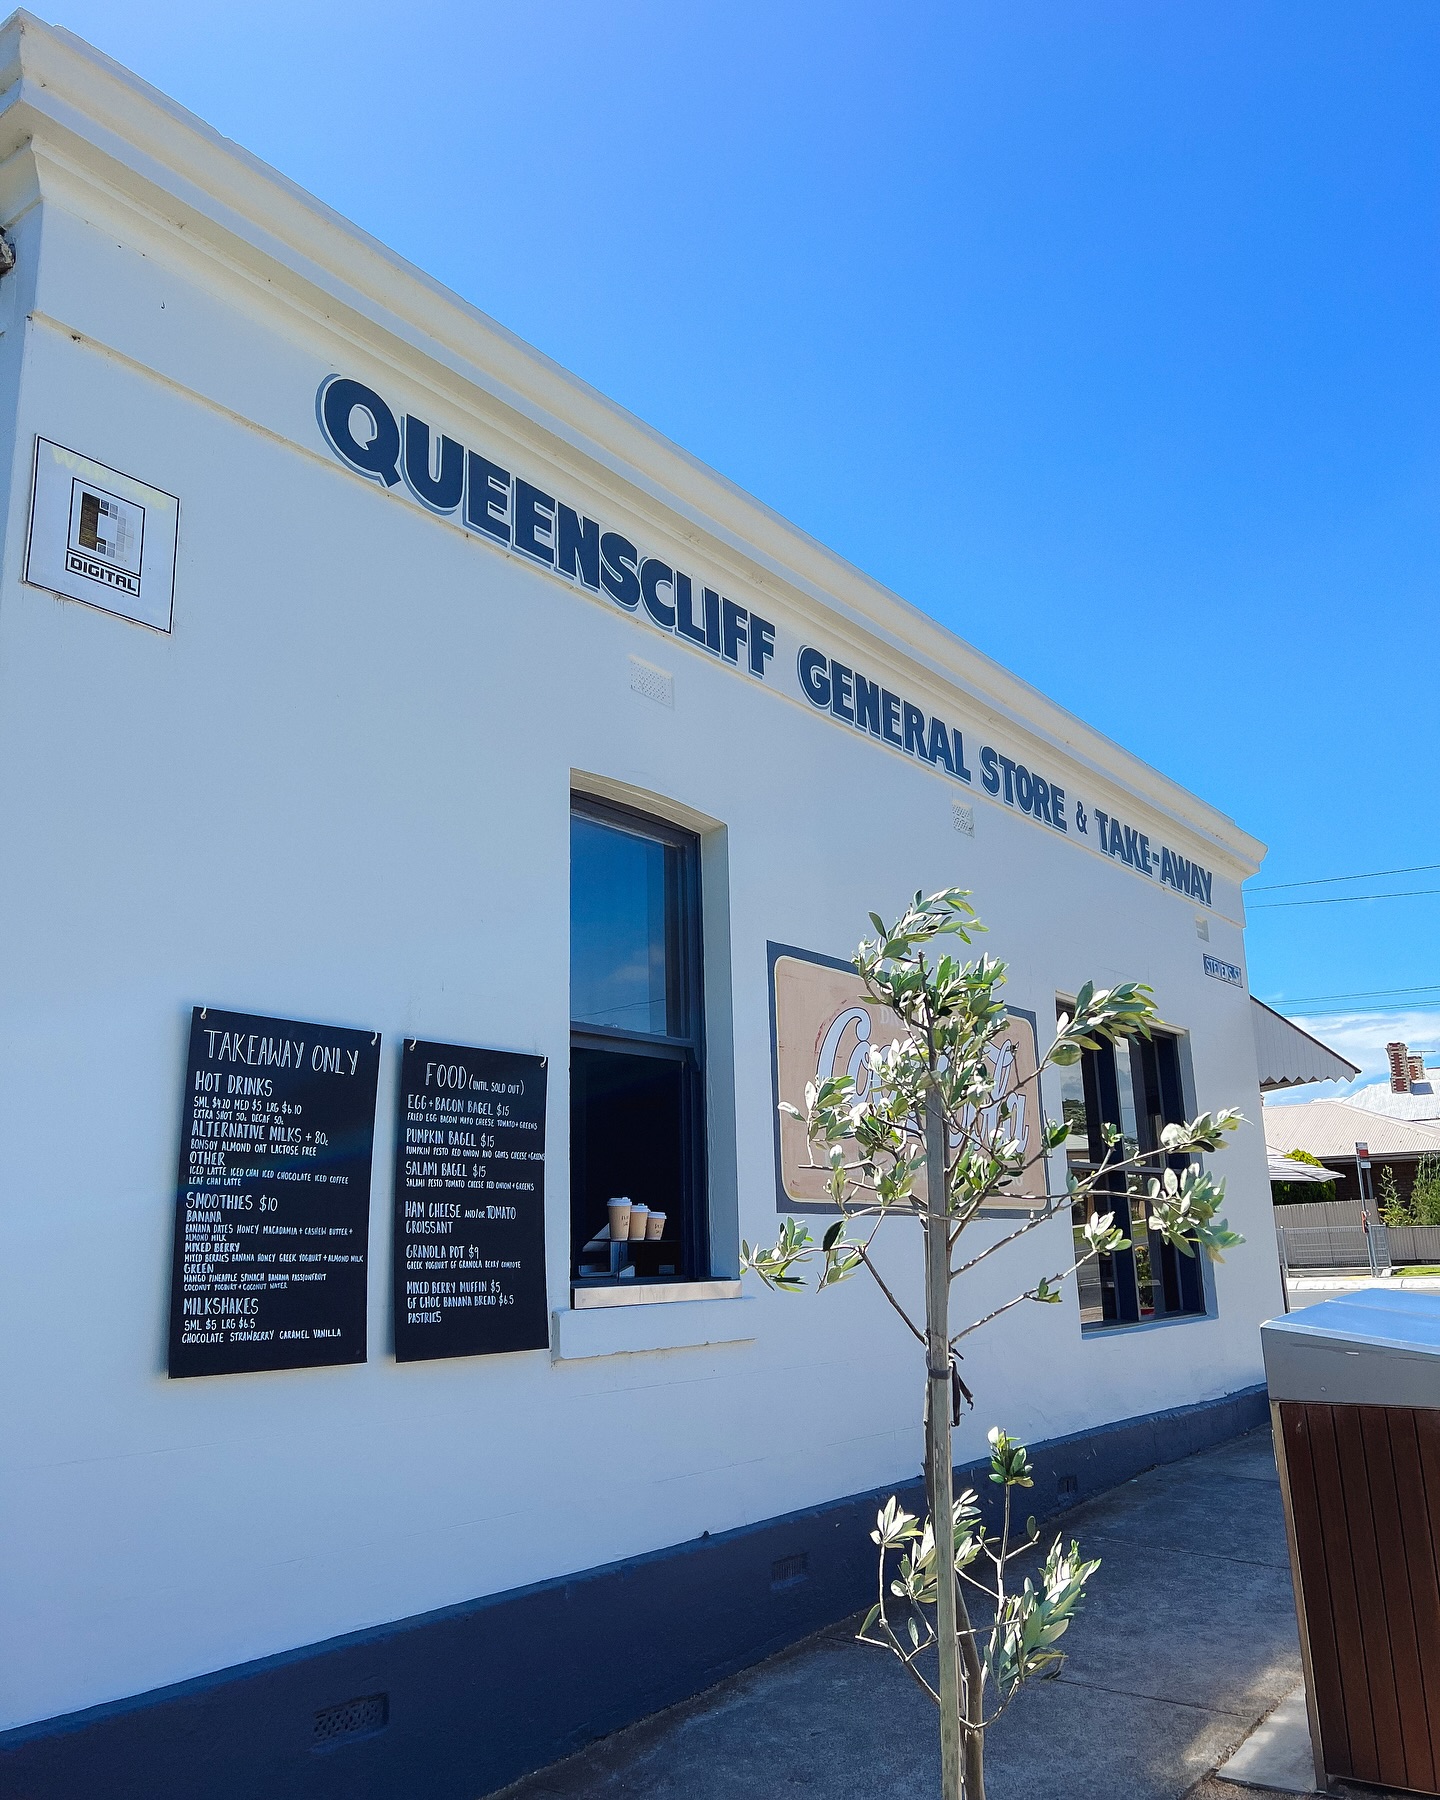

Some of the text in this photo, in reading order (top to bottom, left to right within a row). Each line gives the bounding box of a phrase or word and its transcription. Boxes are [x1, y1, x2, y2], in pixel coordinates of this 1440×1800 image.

[70, 556, 137, 592] DIGITAL
[315, 373, 1213, 907] QUEENSCLIFF GENERAL STORE & TAKE-AWAY
[204, 1030, 359, 1075] TAKEAWAY ONLY
[194, 1071, 273, 1096] HOT DRINKS
[425, 1062, 466, 1089] FOOD
[491, 1082, 505, 1093] SOLD
[194, 1097, 209, 1108] SML
[234, 1099, 249, 1111] MED
[252, 1100, 262, 1112] $5
[266, 1102, 279, 1112] LRG
[282, 1102, 302, 1115] $6.10
[407, 1094, 426, 1110] EGG
[435, 1097, 464, 1113] BACON
[467, 1100, 493, 1116] BAGEL
[496, 1103, 510, 1117] $15
[194, 1109, 213, 1120] EXTRA
[216, 1111, 232, 1121] SHOT
[252, 1114, 270, 1124] DECAF
[407, 1112, 423, 1121] FRIED
[426, 1114, 437, 1122] EGG
[440, 1115, 457, 1124] BACON
[460, 1117, 473, 1125] MAYO
[476, 1118, 494, 1127] CHEESE
[497, 1119, 515, 1128] TOMATO
[520, 1121, 538, 1130] GREENS
[191, 1120, 265, 1140] ALTERNATIVE
[269, 1126, 301, 1142] MILKS
[306, 1133, 312, 1142] +
[406, 1128, 495, 1148] PUMPKIN BAGEL $15
[190, 1139, 317, 1156] BONSOY ALMOND OAT LACTOSE FREE
[406, 1146, 430, 1155] PUMPKIN
[433, 1147, 448, 1156] PESTO
[451, 1148, 461, 1156] RED
[463, 1148, 479, 1157] ONION
[511, 1152, 526, 1160] CHEESE
[189, 1152, 225, 1166] OTHER
[190, 1167, 348, 1184] ICED LATTE ICED CHAI ICED CHOCOLATE ICED COFFEE
[405, 1161, 486, 1178] SALAMI BAGEL $15
[189, 1177, 241, 1186] LEAF CHAI LATTE
[406, 1178, 425, 1187] SALAMI
[428, 1178, 442, 1188] PESTO
[445, 1179, 465, 1188] TOMATO
[468, 1180, 484, 1189] CHEESE
[486, 1180, 494, 1189] RED
[496, 1181, 512, 1190] ONION
[516, 1182, 534, 1191] GREENS
[186, 1191, 278, 1212] SMOOTHIES $10
[186, 1210, 222, 1223] BANANA
[405, 1201, 424, 1218] HAM
[428, 1203, 462, 1218] CHEESE
[486, 1205, 516, 1220] TOMATO
[185, 1224, 211, 1234] BANANA
[214, 1224, 233, 1234] DATES
[236, 1225, 259, 1235] HONEY
[263, 1226, 297, 1236] MACADAMIA
[305, 1227, 326, 1236] CASHEW
[329, 1228, 348, 1236] BUTTER
[406, 1220, 453, 1234] CROISSANT
[185, 1234, 226, 1242] ALMOND MILK
[185, 1242, 240, 1252] MIXED BERRY
[406, 1244, 479, 1259] GRANOLA POT $9
[184, 1254, 202, 1263] MIXED
[205, 1254, 229, 1263] BERRIES
[232, 1254, 254, 1262] BANANA
[257, 1254, 276, 1263] HONEY
[279, 1254, 296, 1263] GREEK
[328, 1255, 349, 1263] ALMOND
[407, 1260, 422, 1270] GREEK
[450, 1260, 457, 1269] GF
[459, 1260, 482, 1269] GRANOLA
[485, 1260, 500, 1268] BERRY
[184, 1264, 214, 1274] GREEN
[184, 1274, 206, 1282] MANGO
[208, 1273, 237, 1282] PINEAPPLE
[240, 1273, 265, 1282] SPINACH
[268, 1274, 289, 1282] BANANA
[184, 1283, 210, 1291] COCONUT
[243, 1283, 266, 1291] COCONUT
[270, 1282, 288, 1290] WATER
[407, 1279, 500, 1294] MIXED BERRY MUFFIN $5
[183, 1297, 259, 1315] MILKSHAKES
[407, 1296, 417, 1308] GF
[420, 1296, 441, 1308] CHOC
[443, 1296, 472, 1307] BANANA
[474, 1296, 496, 1306] BREAD
[184, 1320, 202, 1331] SML
[205, 1319, 217, 1331] $5
[222, 1319, 235, 1329] LRG
[408, 1311, 441, 1324] PASTRIES
[182, 1329, 341, 1344] CHOCOLATE STRAWBERRY CARAMEL VANILLA
